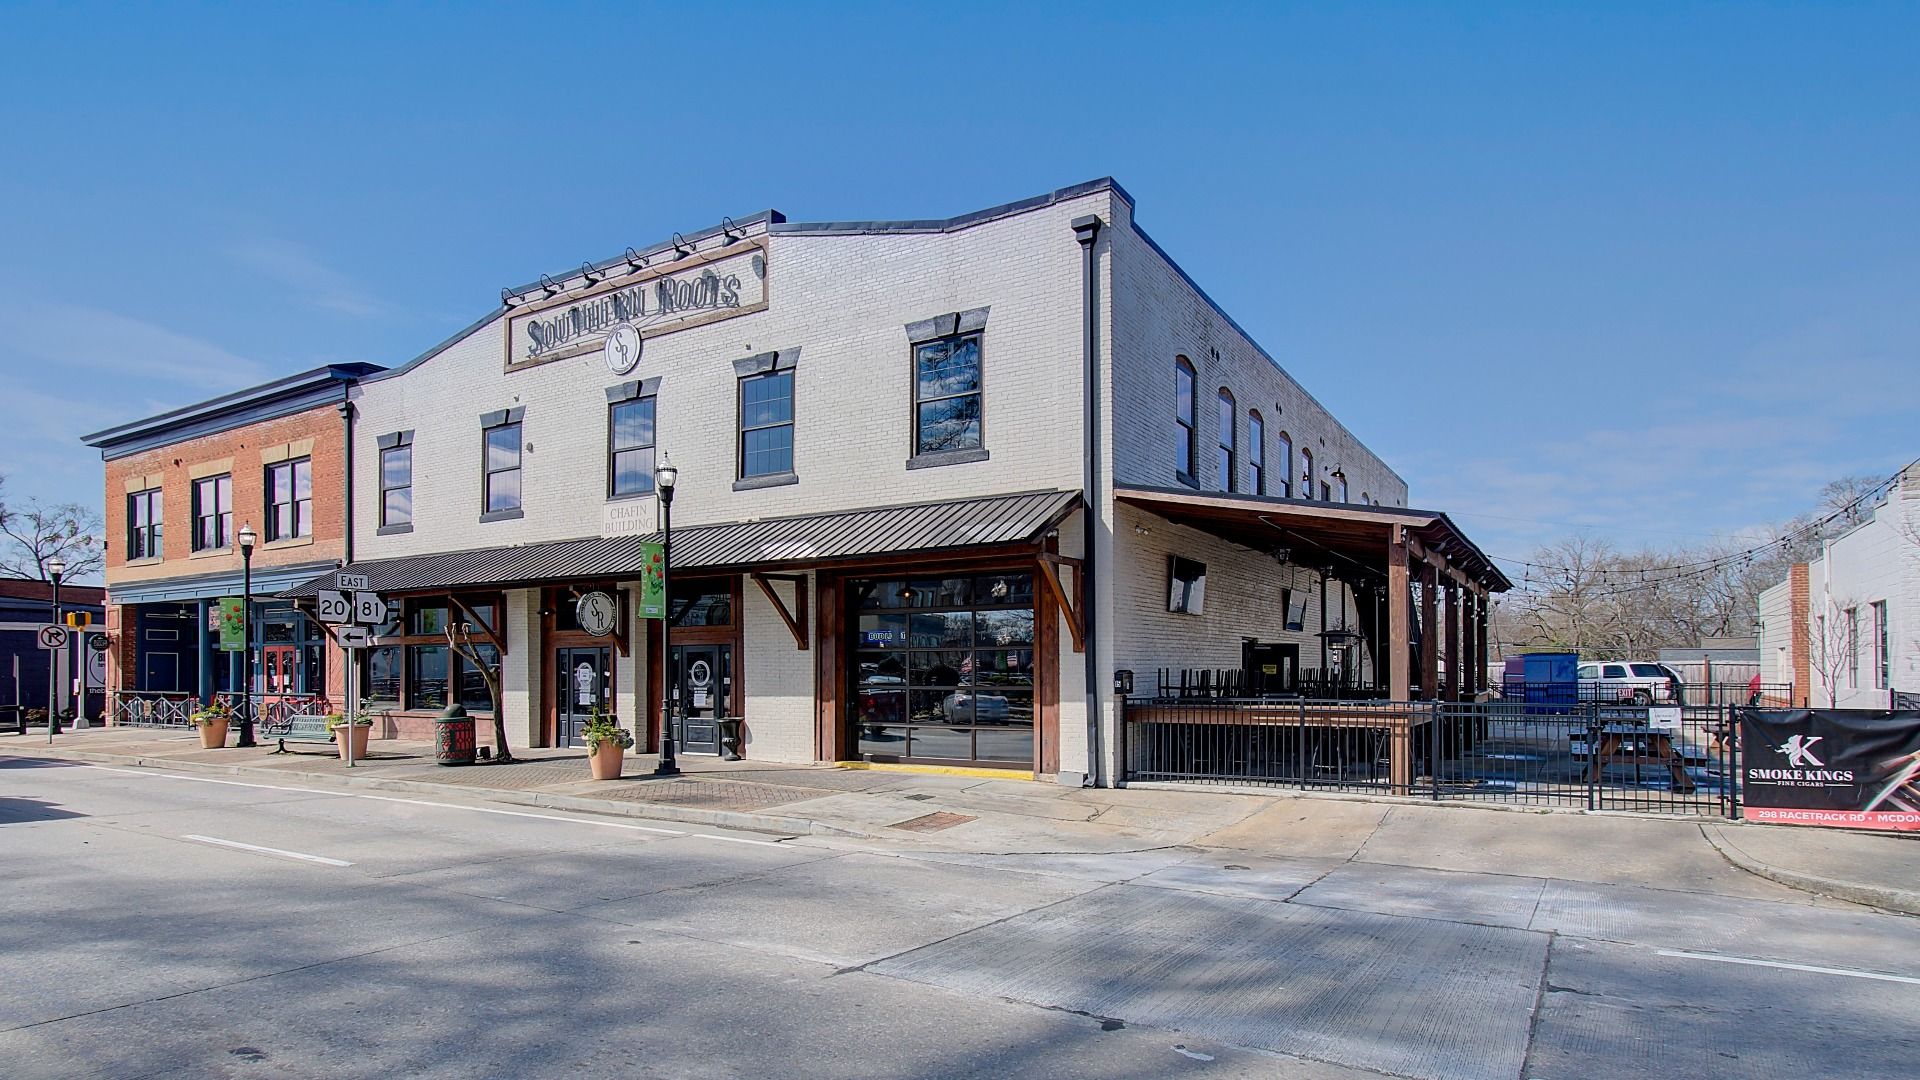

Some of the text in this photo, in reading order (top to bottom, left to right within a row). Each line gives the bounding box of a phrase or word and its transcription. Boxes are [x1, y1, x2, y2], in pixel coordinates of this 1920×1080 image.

[610, 504, 647, 519] CHAFIN
[604, 517, 653, 533] BUILDING
[341, 575, 364, 587] EAST
[321, 599, 345, 616] 20
[362, 601, 379, 617] 81
[1618, 688, 1632, 697] EXIT
[1749, 768, 1853, 782] SMOKE KINGS
[1758, 811, 1777, 819] 298
[1779, 811, 1846, 822] RACETRACK
[1850, 813, 1866, 822] RD
